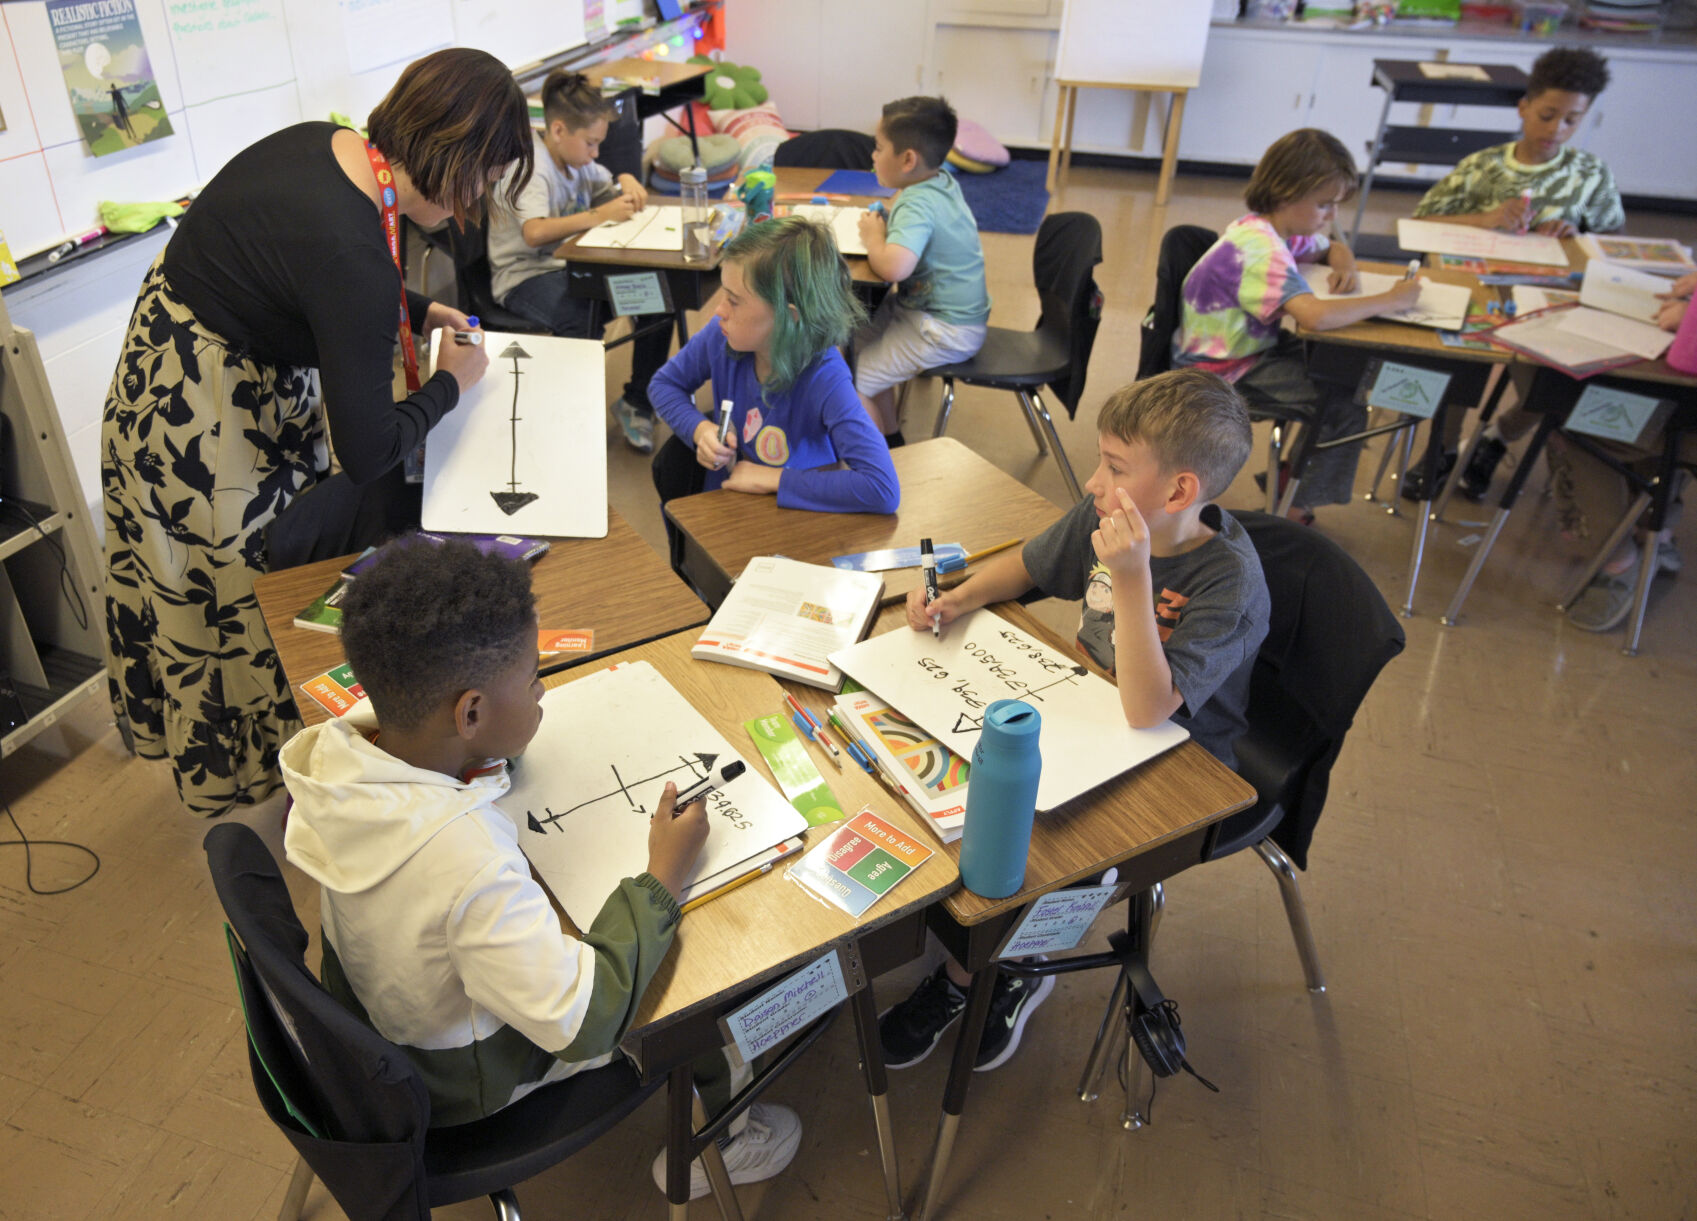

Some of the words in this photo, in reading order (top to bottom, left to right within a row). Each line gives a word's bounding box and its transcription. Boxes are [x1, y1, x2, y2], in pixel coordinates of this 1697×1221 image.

[50, 2, 100, 26] REALISTIC
[99, 0, 134, 18] FICTION
[314, 683, 332, 695] Add
[332, 695, 350, 710] More
[828, 836, 862, 862] Disagree
[863, 820, 887, 838] More
[885, 834, 897, 844] to
[895, 841, 917, 856] Add
[867, 860, 893, 881] Agree
